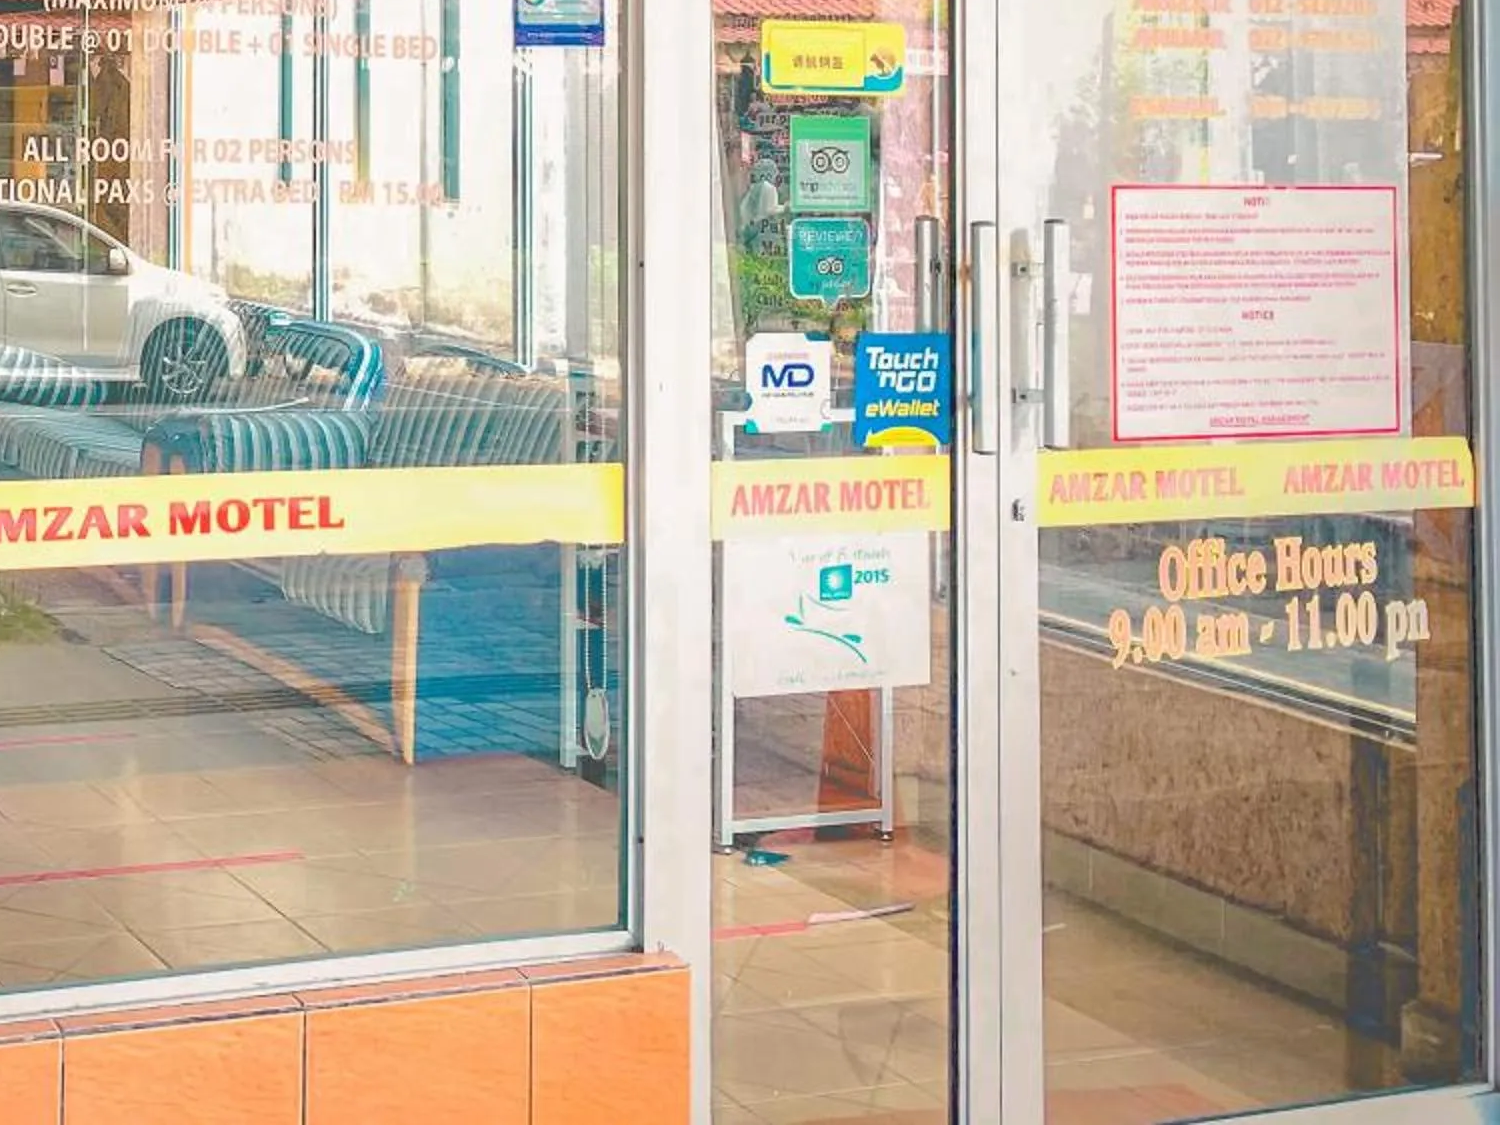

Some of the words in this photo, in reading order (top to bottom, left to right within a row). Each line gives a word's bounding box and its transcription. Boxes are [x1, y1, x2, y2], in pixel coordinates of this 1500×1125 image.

[81, 30, 100, 54] @
[107, 28, 133, 51] 01
[303, 33, 387, 59] SINGLE
[392, 35, 438, 60] BED
[23, 137, 69, 162] ALL
[76, 137, 153, 163] ROOM
[213, 139, 242, 164] 02
[248, 139, 358, 165] PERSONS
[94, 178, 155, 205] PAXS
[191, 179, 266, 205] EXTRA
[338, 179, 375, 205] RM
[865, 346, 939, 370] Touch
[864, 399, 941, 417] eWallet
[1049, 470, 1148, 505] AMZAR
[1156, 466, 1245, 499] MOTEL
[1283, 463, 1374, 494] AMZAR
[1381, 459, 1465, 491] MOTEL
[730, 481, 832, 517] AMZAR
[839, 478, 932, 512] MOTEL
[168, 495, 345, 536] MOTEL
[853, 568, 891, 585] 2015
[1158, 537, 1268, 602] Office
[1273, 536, 1378, 592] Hours
[1108, 603, 1187, 670] 9.00
[1194, 608, 1251, 659] am
[1259, 619, 1276, 644] -
[1286, 591, 1378, 652] 11.00
